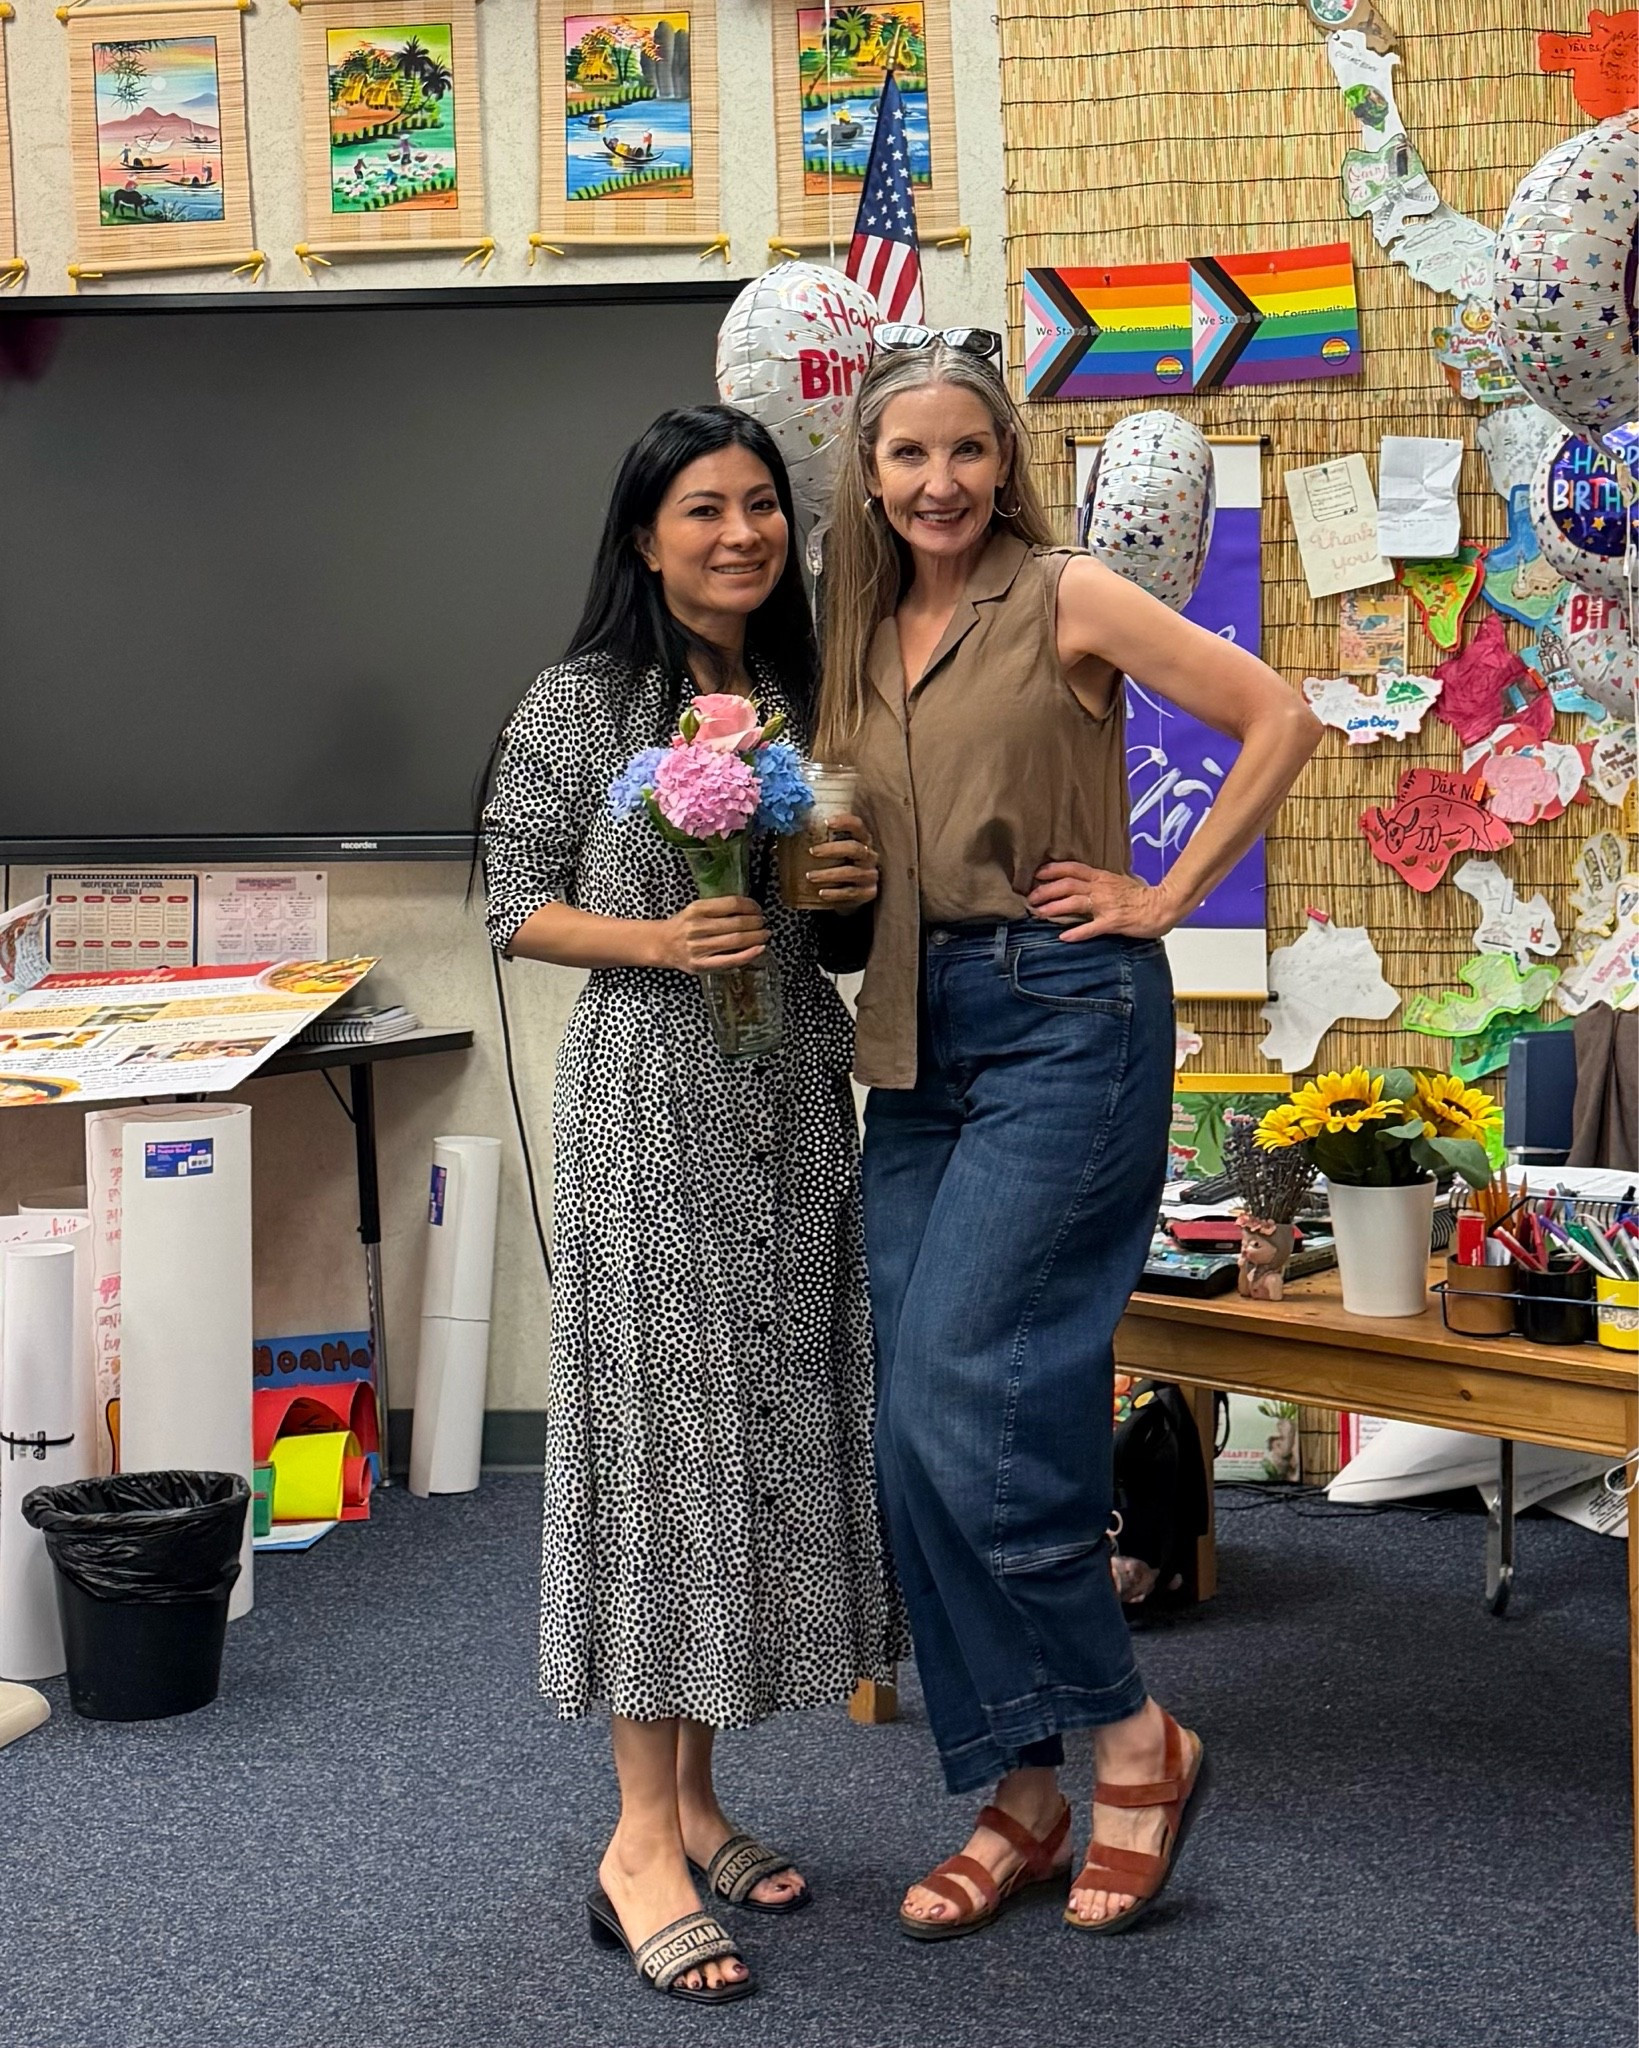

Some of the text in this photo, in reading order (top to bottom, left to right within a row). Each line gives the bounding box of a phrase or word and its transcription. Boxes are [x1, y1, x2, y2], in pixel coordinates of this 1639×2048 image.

[1198, 315, 1216, 326] We
[1218, 313, 1251, 325] Stand
[1283, 303, 1347, 320] Community
[1036, 326, 1053, 337] We
[1055, 325, 1088, 337] Stand
[1118, 322, 1184, 336] Community
[643, 1924, 720, 1980] CHRISTIAN
